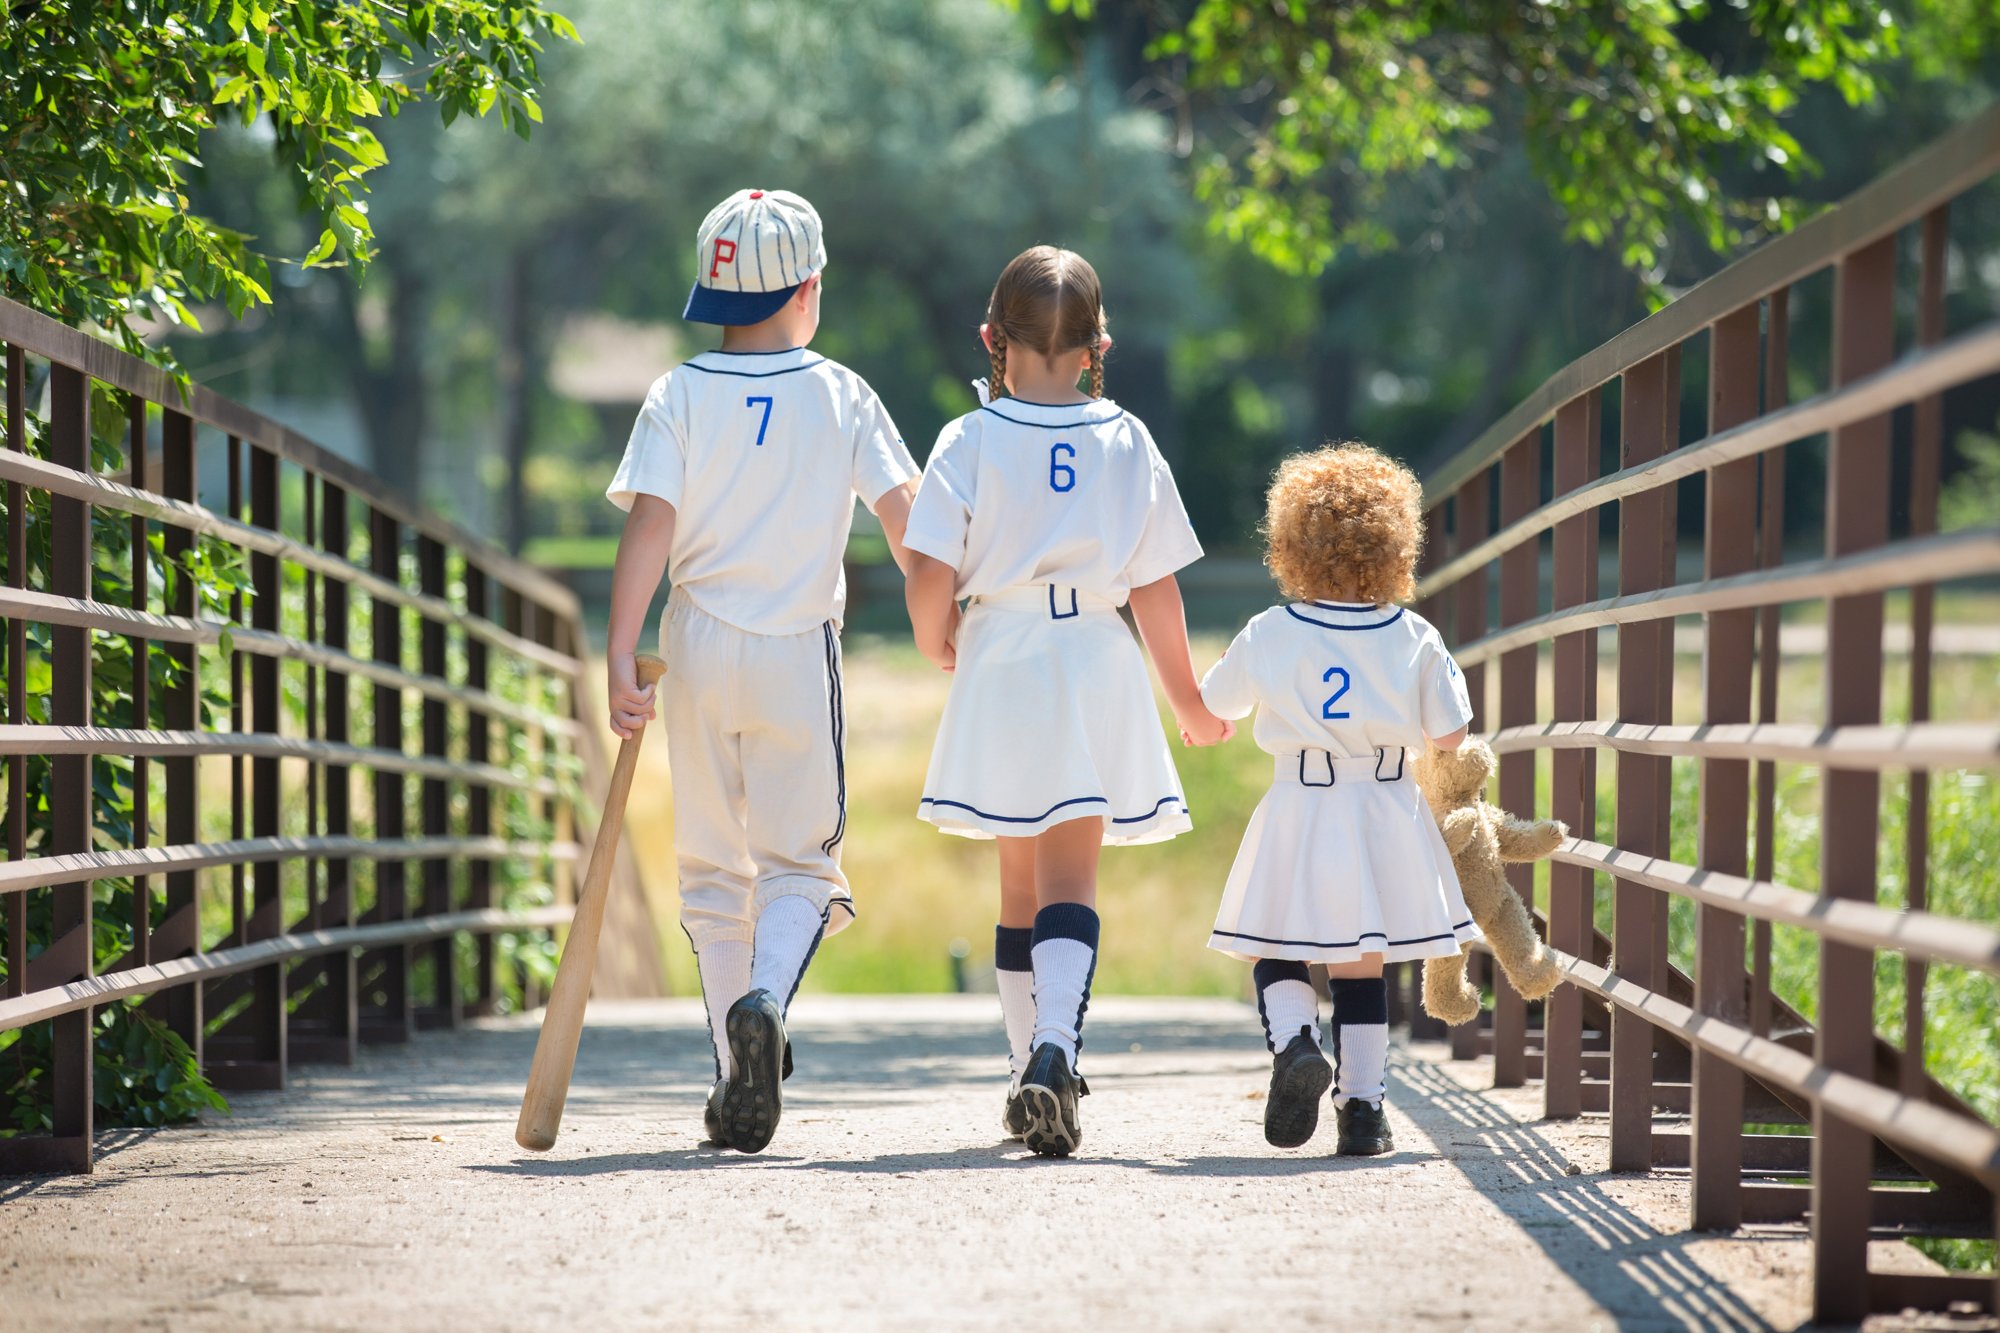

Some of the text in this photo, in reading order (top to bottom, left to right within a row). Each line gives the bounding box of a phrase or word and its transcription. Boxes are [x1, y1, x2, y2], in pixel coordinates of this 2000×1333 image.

[710, 238, 737, 278] P
[745, 395, 774, 446] 7
[1049, 442, 1077, 493] 6
[1322, 666, 1351, 720] 2
